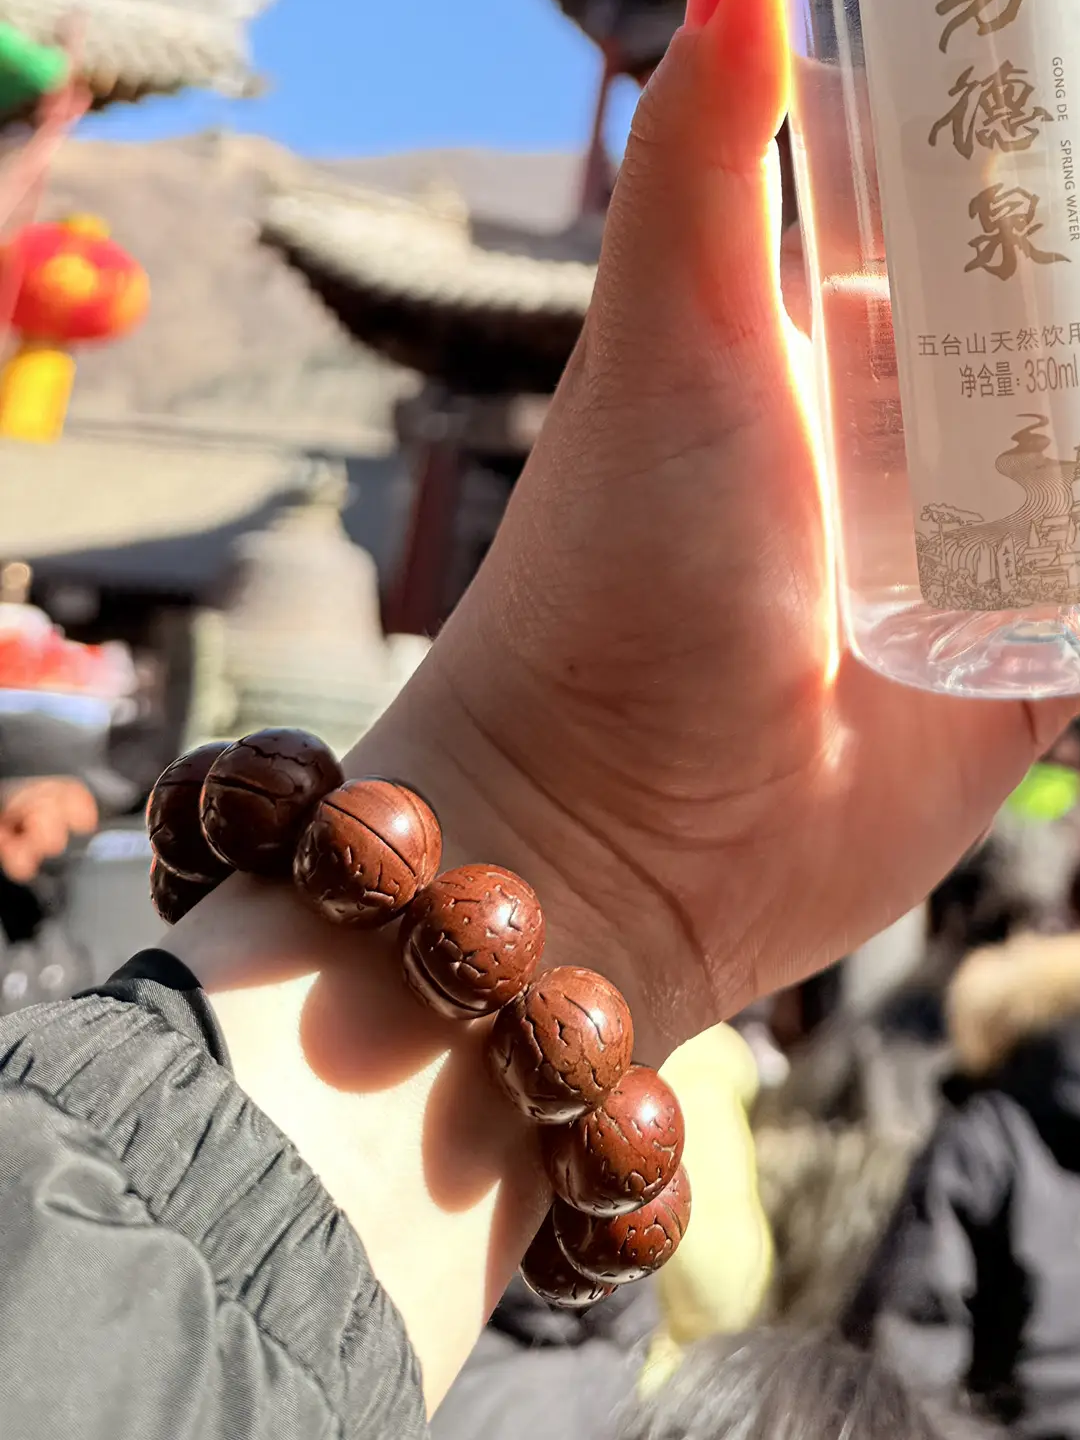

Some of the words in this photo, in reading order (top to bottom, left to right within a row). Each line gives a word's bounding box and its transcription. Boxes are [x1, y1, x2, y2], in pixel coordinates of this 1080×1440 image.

[1052, 56, 1067, 99] GONG
[1057, 103, 1069, 122] DE
[1060, 139, 1076, 191] SPRING
[1066, 194, 1080, 242] WATER
